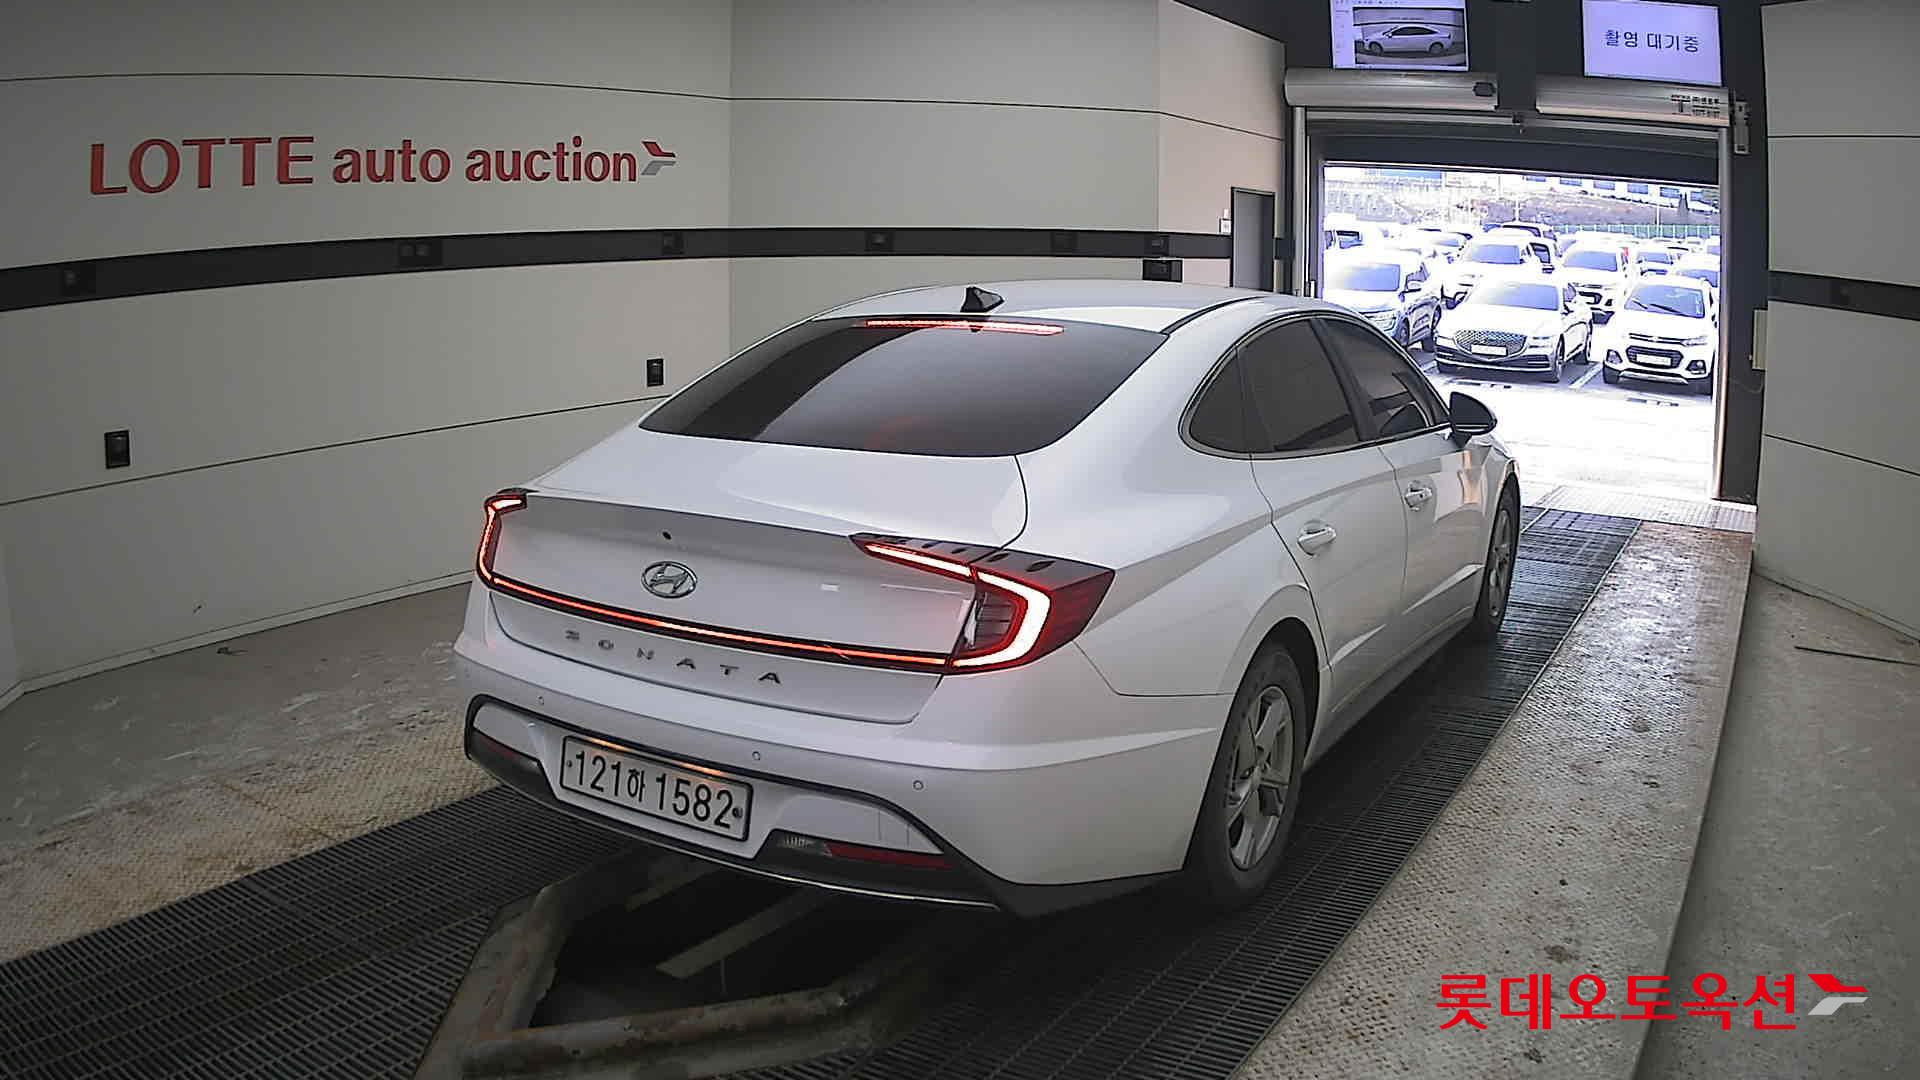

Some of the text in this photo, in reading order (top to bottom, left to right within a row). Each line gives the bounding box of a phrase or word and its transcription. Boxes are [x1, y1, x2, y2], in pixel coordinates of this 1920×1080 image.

[1605, 30, 1699, 53] 촬영 대기중
[90, 135, 638, 195] LOTTE auto auction
[565, 629, 781, 685] SONATA
[576, 750, 734, 829] 121하 1582
